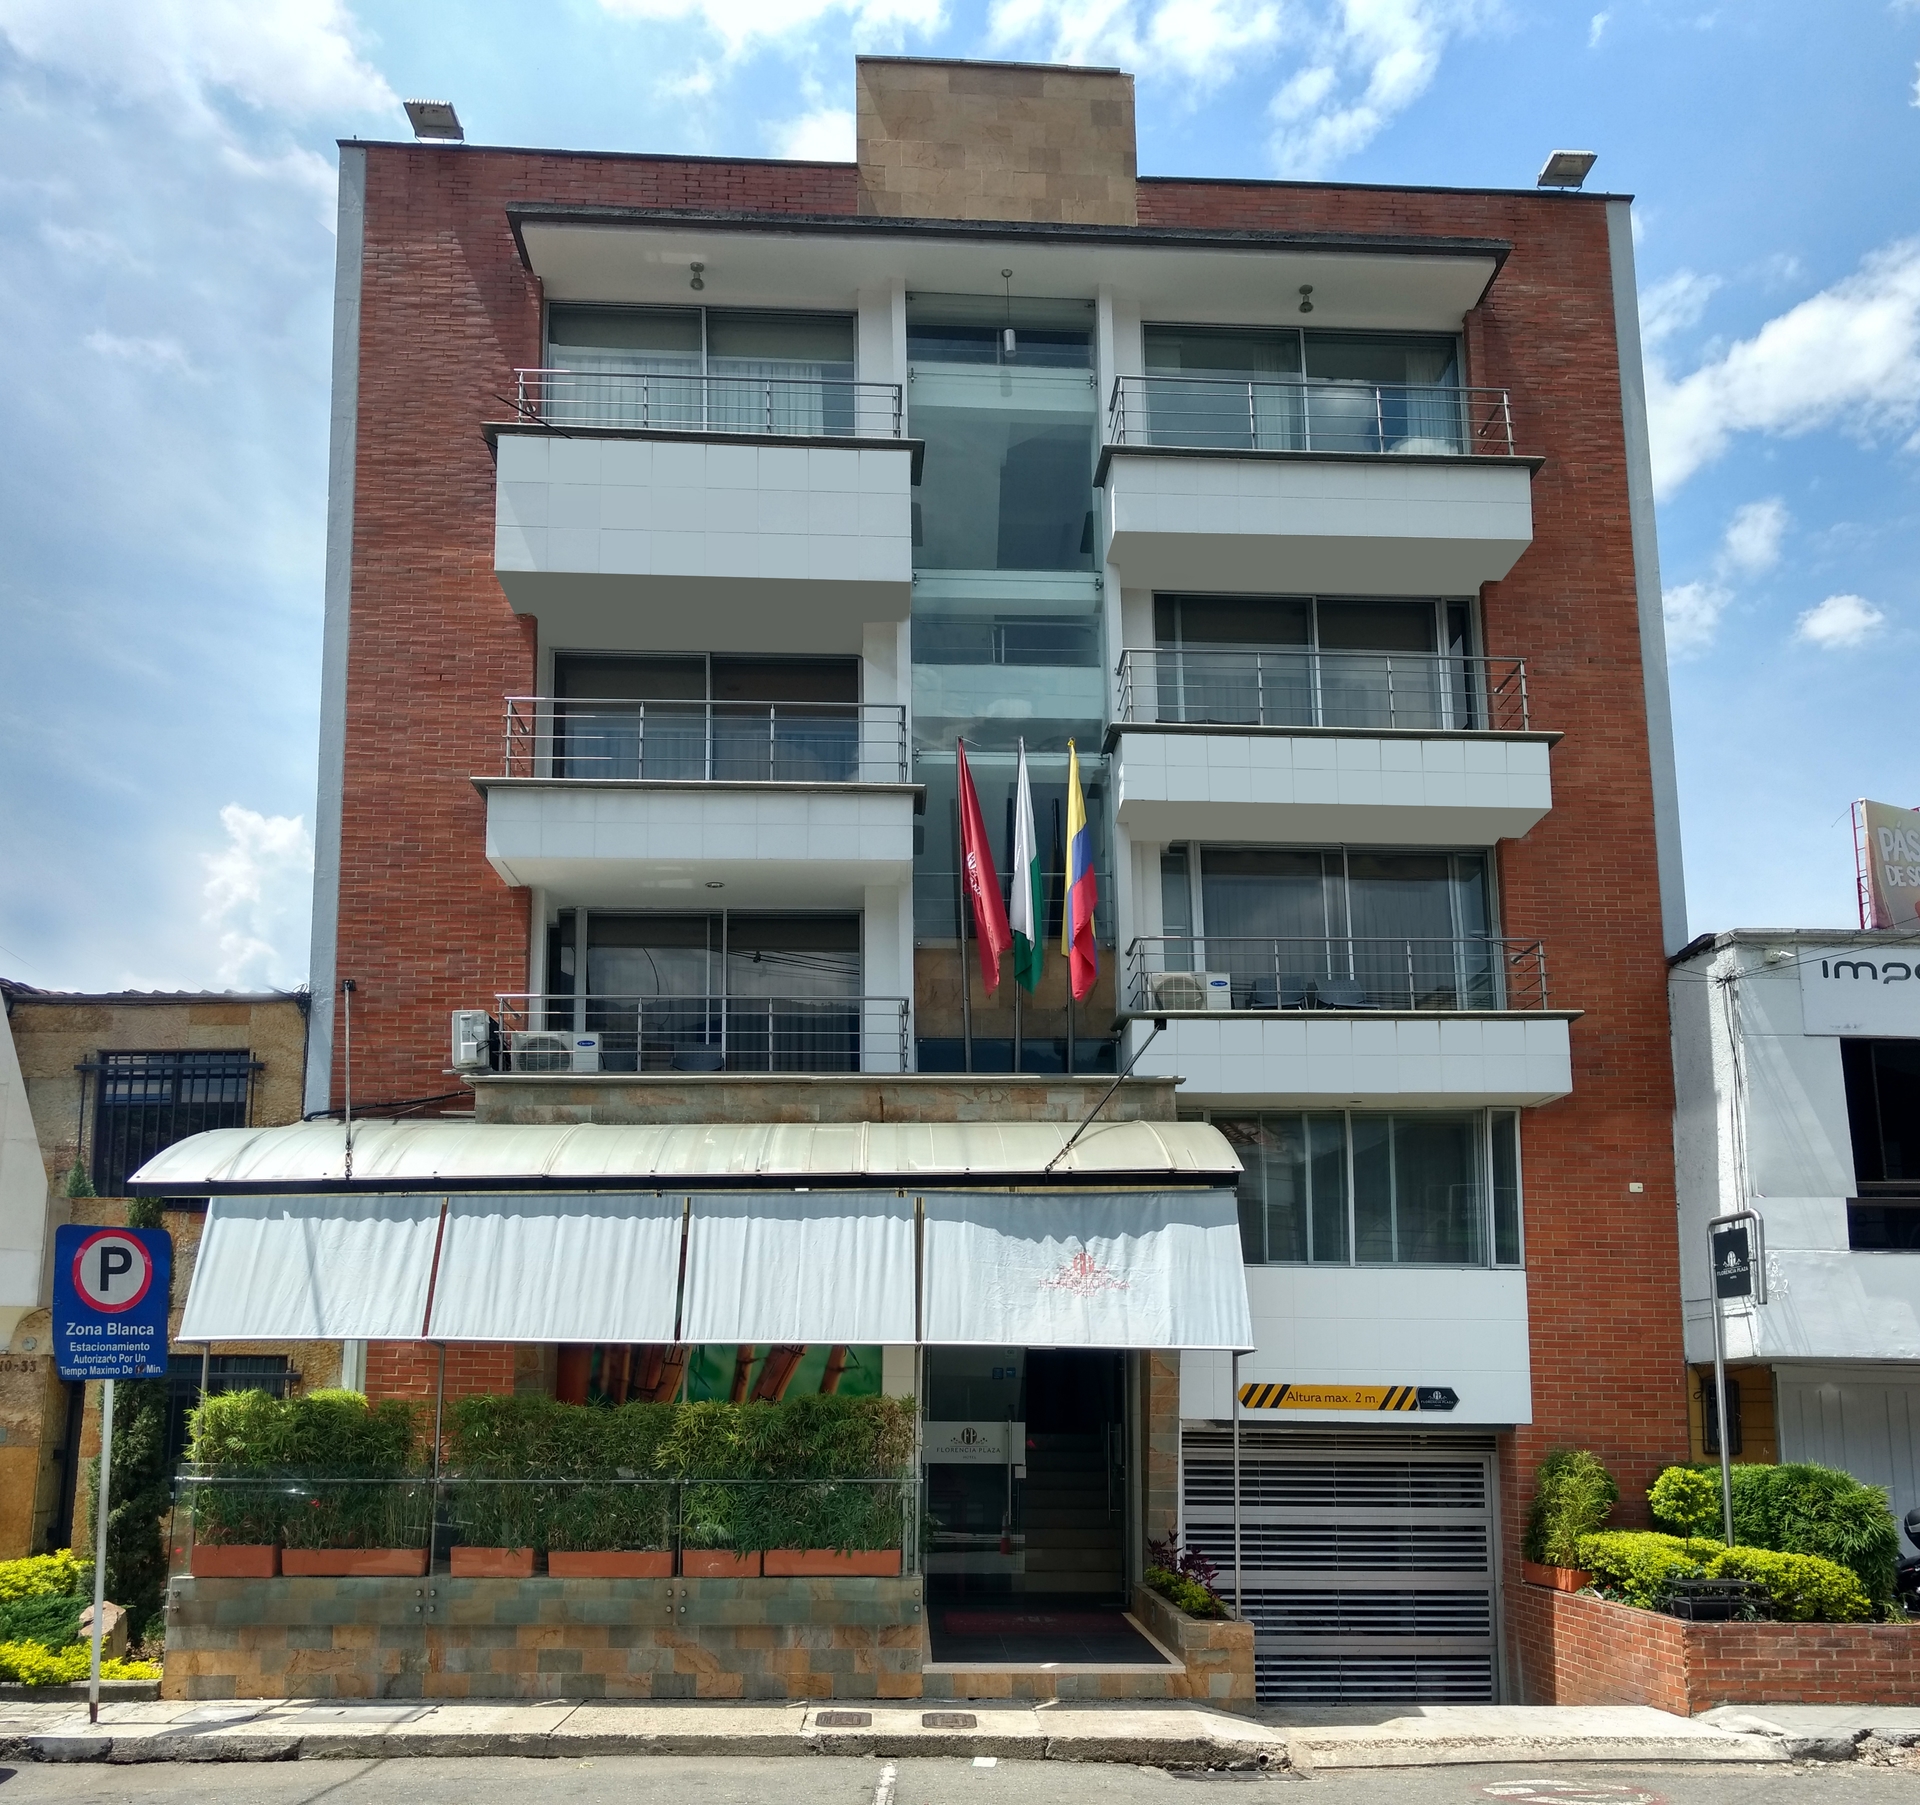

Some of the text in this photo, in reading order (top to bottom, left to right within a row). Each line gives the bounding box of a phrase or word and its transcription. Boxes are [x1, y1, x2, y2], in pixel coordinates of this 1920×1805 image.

[1885, 865, 1907, 887] DE
[100, 1246, 132, 1291] P
[65, 1322, 154, 1336] Zona Blanca
[70, 1341, 150, 1352] Estacionamiento
[73, 1354, 146, 1364] Autorizado Por Un
[60, 1366, 88, 1377] Tiempo
[89, 1365, 120, 1375] Maximo
[122, 1365, 133, 1374] De
[146, 1364, 163, 1374] Min.
[1286, 1391, 1379, 1403] Altura max. 2 m.
